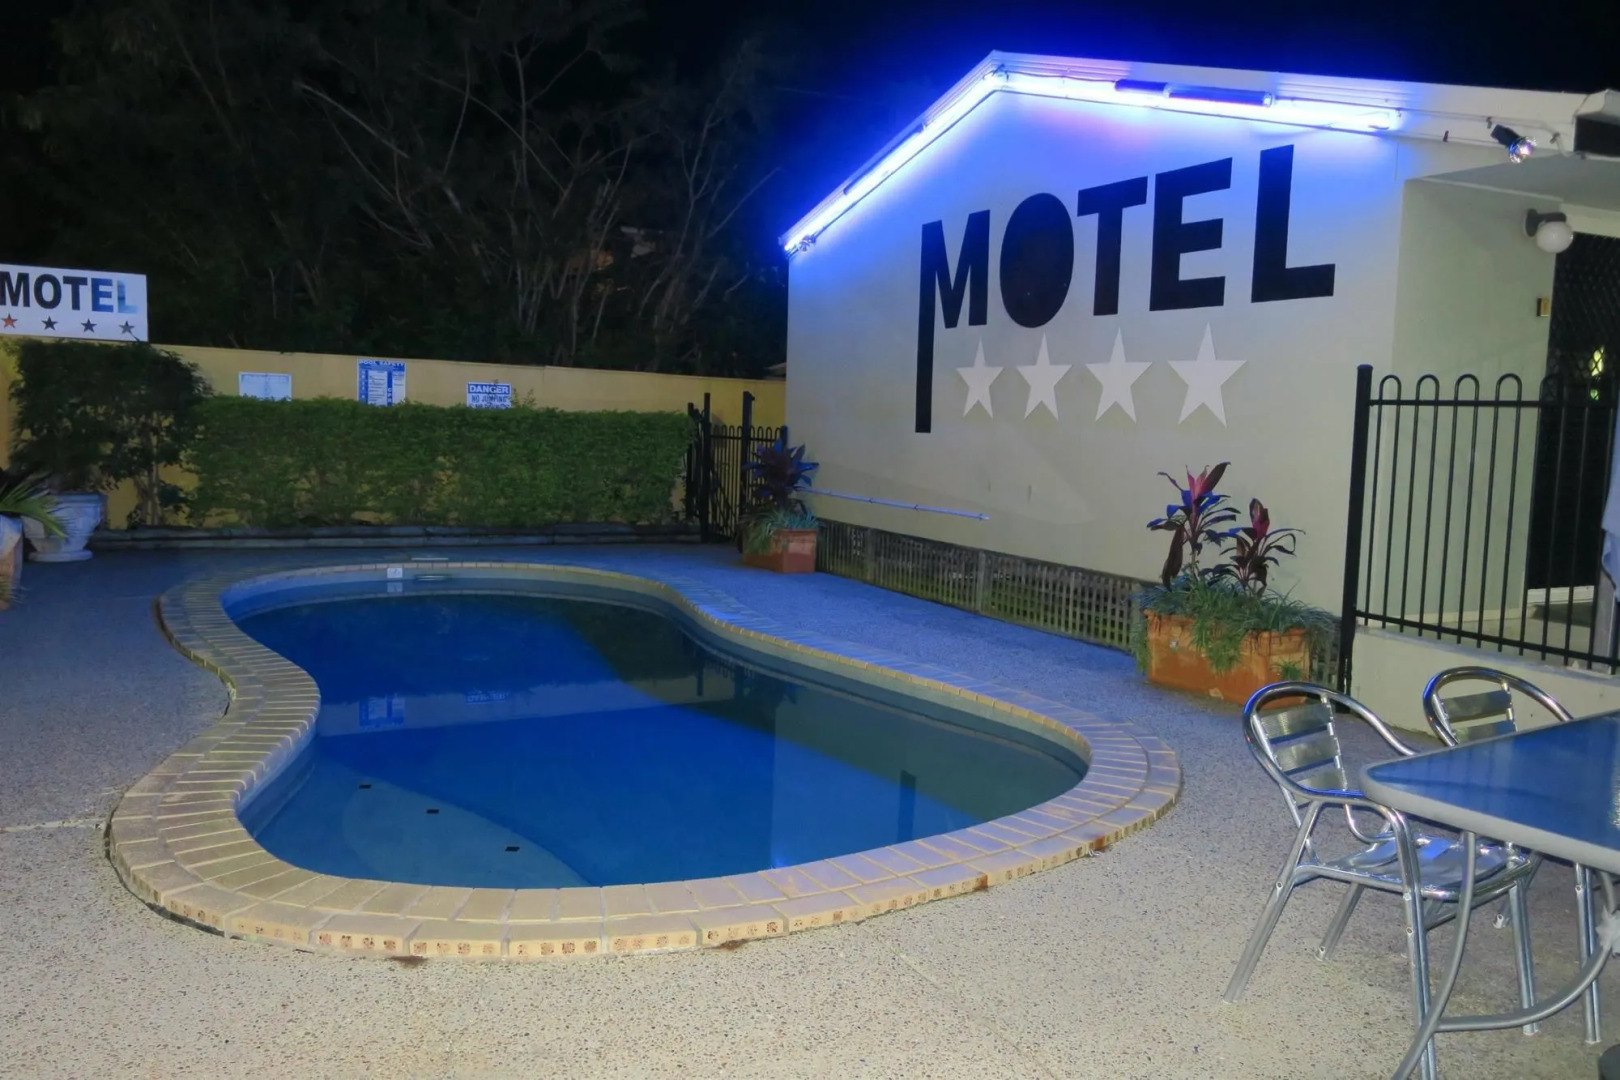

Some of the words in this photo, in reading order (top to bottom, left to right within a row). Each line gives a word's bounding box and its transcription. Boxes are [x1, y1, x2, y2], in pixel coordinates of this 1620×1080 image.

[0, 270, 138, 314] MOTEL
[914, 143, 1336, 434] MOTEL
[469, 385, 509, 394] DANGER
[471, 395, 480, 403] NO
